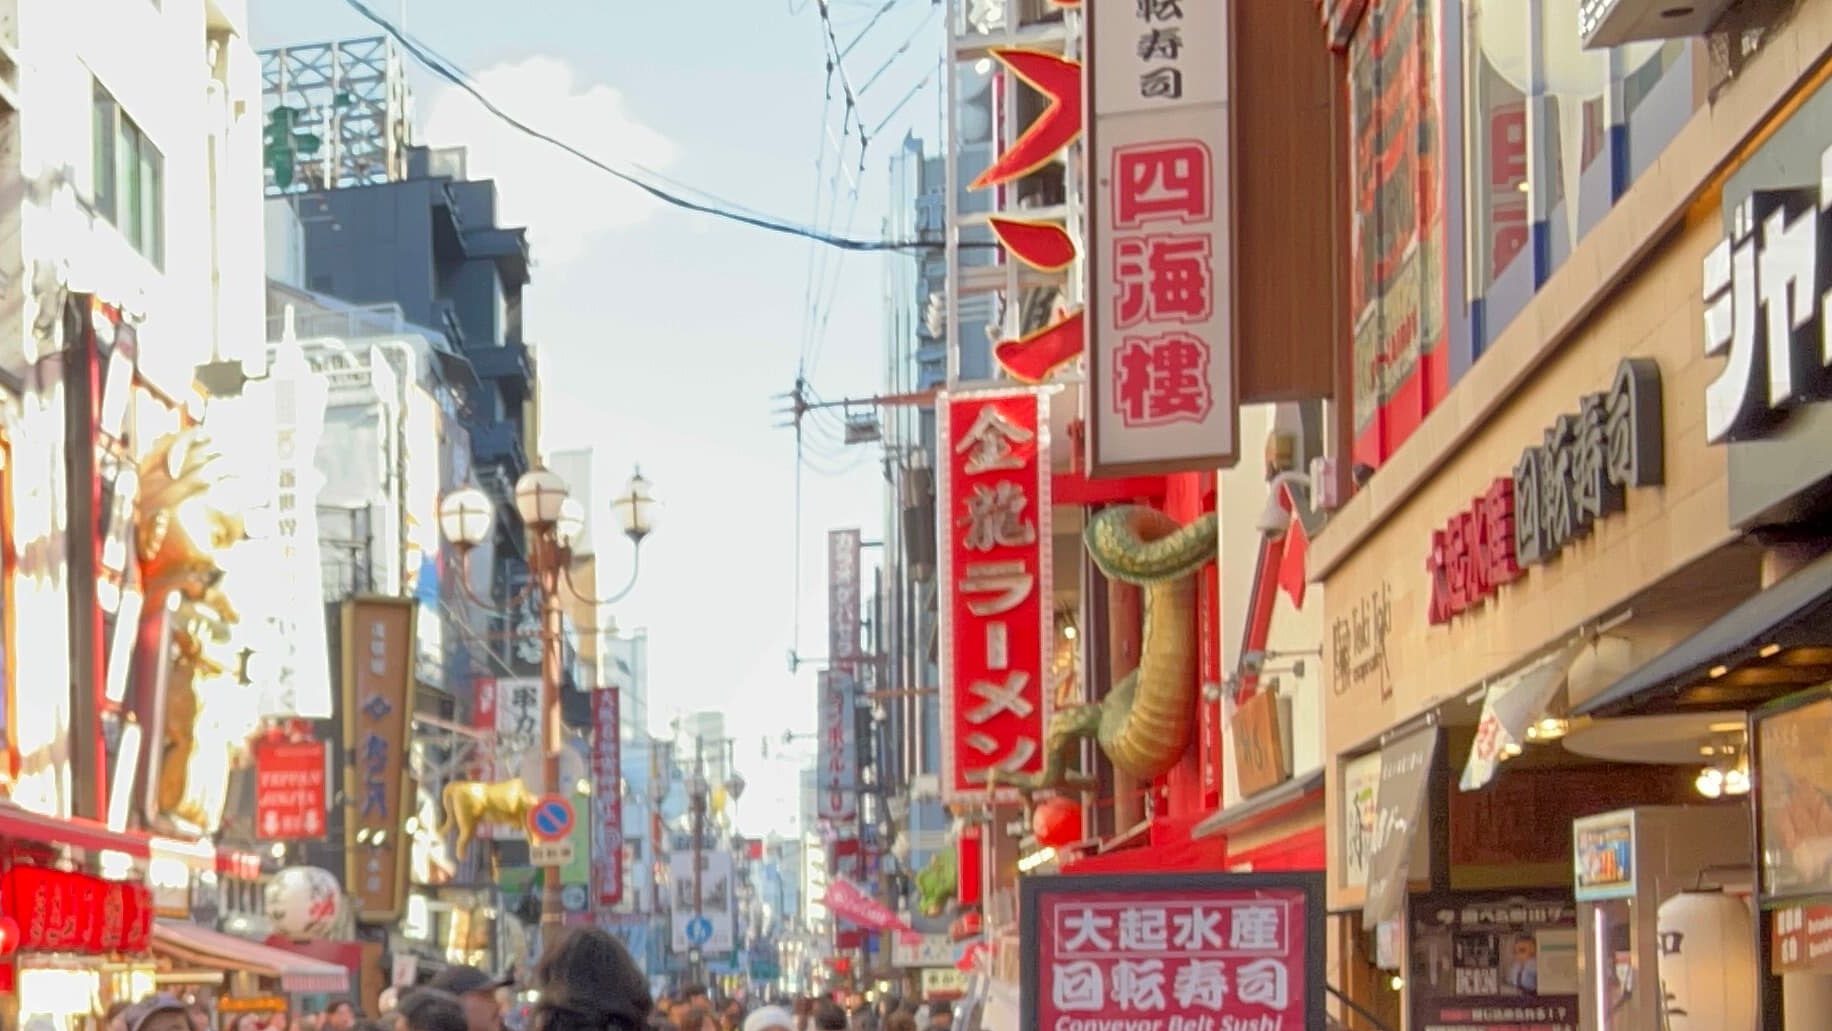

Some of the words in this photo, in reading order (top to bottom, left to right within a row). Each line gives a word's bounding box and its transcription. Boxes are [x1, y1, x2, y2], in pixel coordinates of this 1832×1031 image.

[1112, 138, 1212, 427] 四海樓
[955, 406, 1044, 788] 金龍ラーメン
[1051, 959, 1288, 1011] 回転寿司
[1064, 906, 1279, 951] 大起水産
